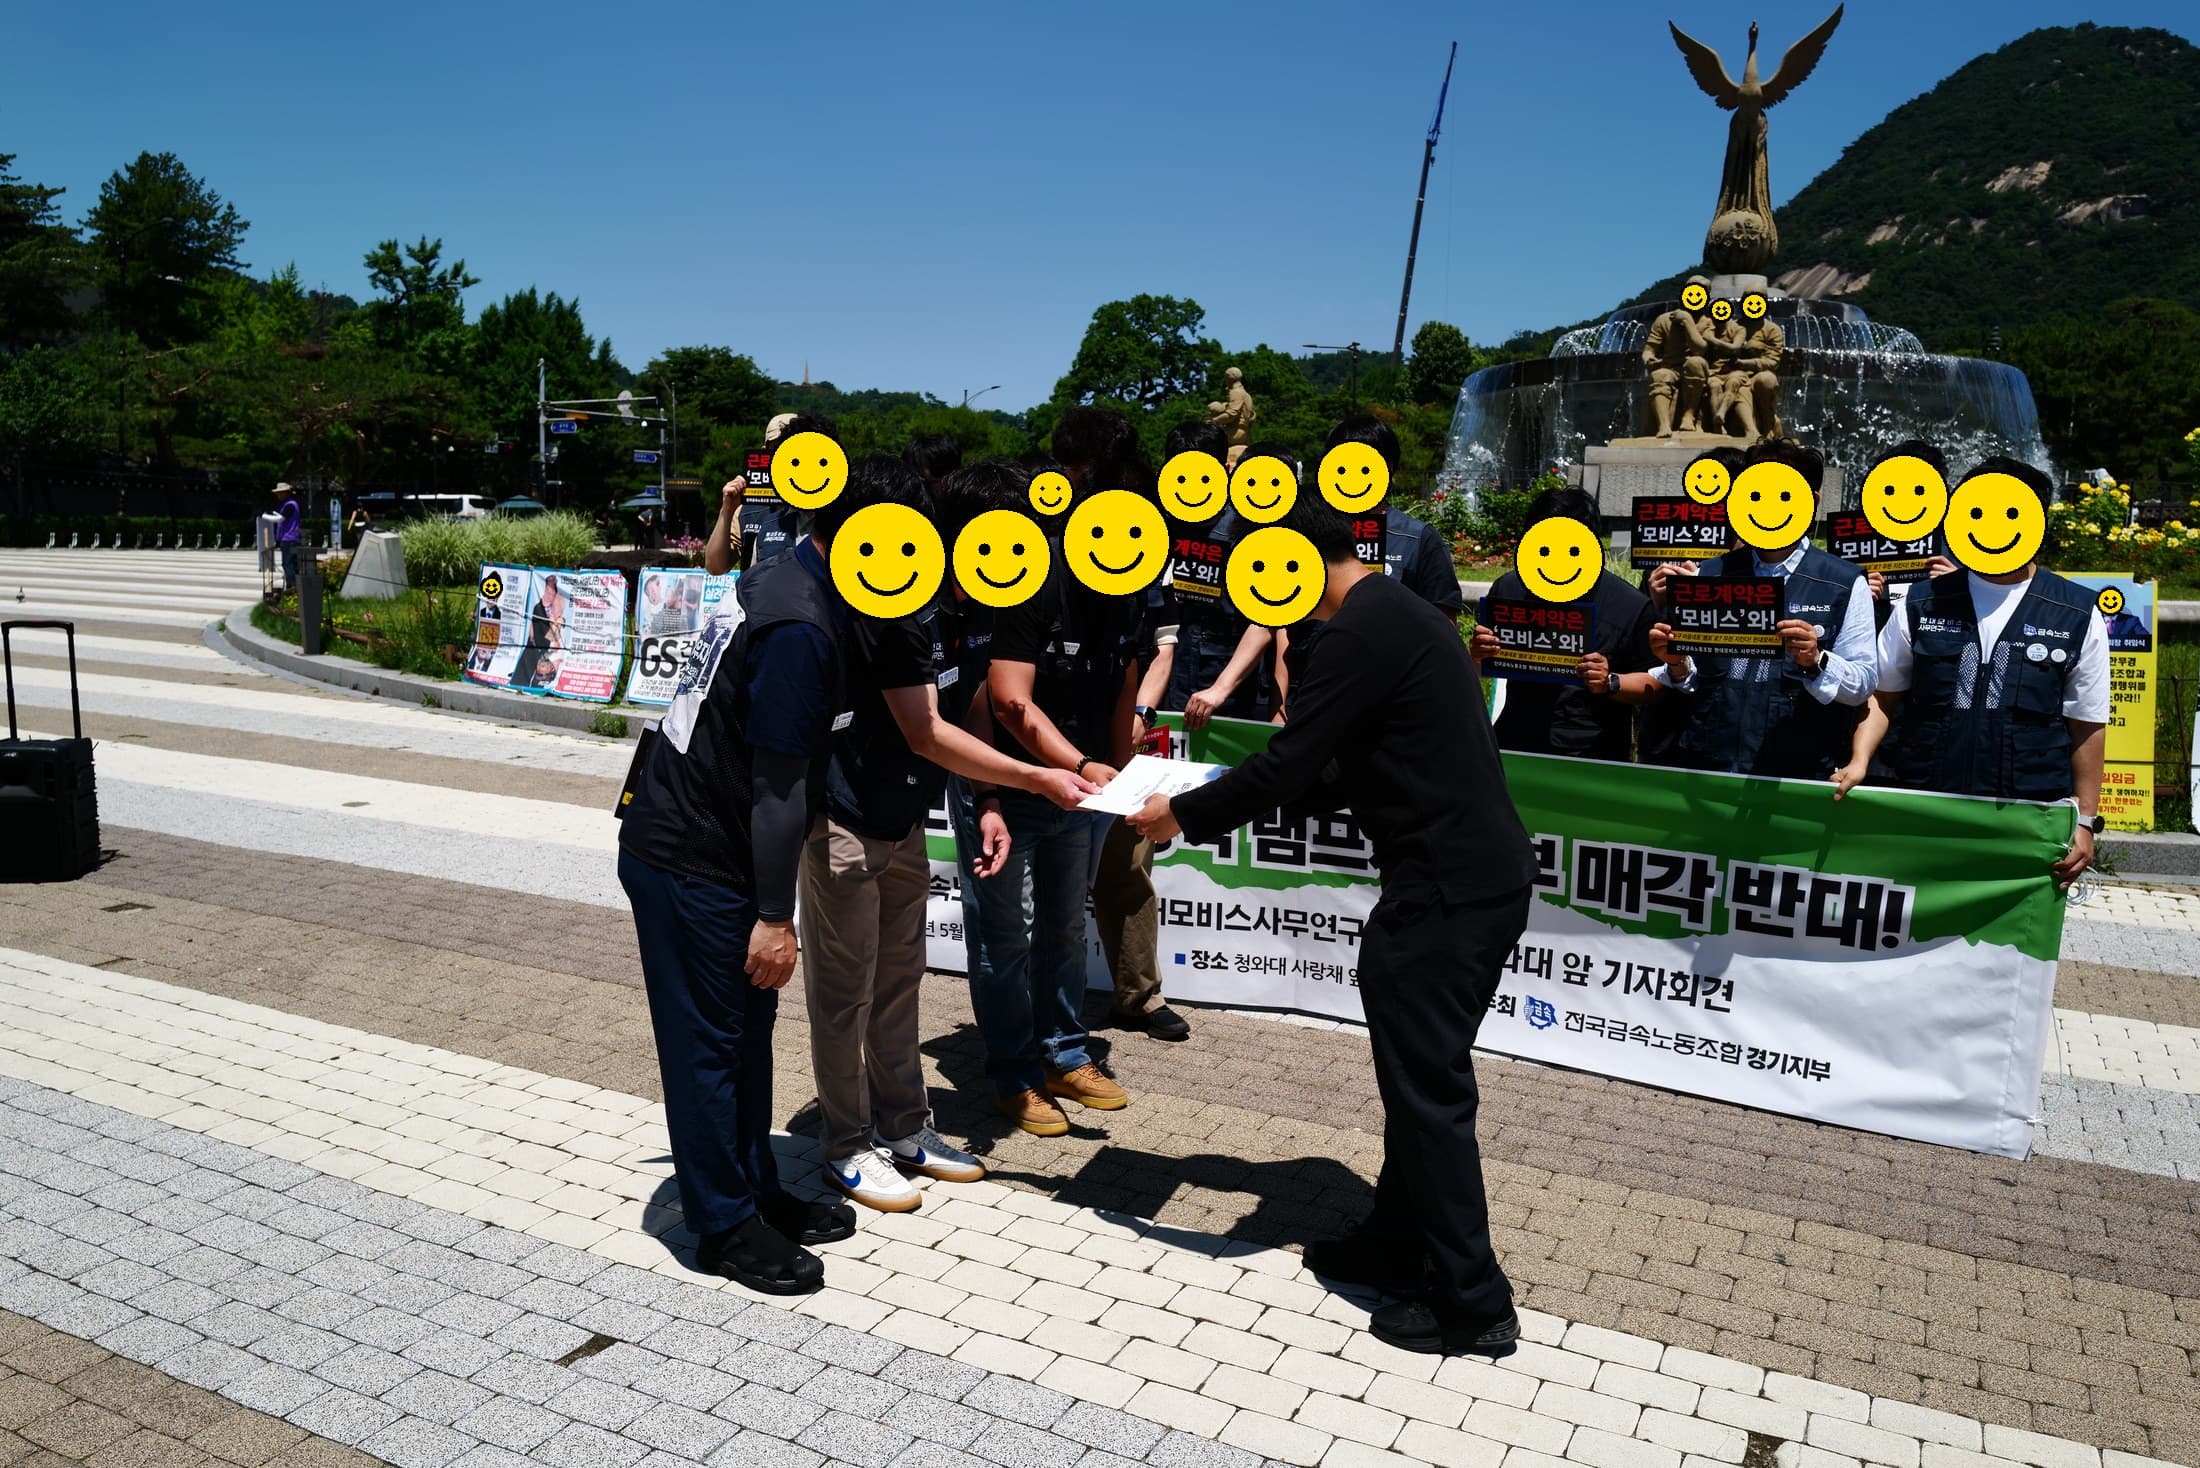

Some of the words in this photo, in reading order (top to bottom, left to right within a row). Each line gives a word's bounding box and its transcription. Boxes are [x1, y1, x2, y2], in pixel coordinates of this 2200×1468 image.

[747, 453, 771, 468] 근로
[1637, 502, 1726, 522] 근로계약은
[1833, 517, 1872, 537] 근로
[1174, 539, 1223, 563] 계약은
[1355, 543, 1379, 561] 와!
[1173, 560, 1220, 584] 스’와!
[1673, 583, 1777, 605] 근로계약은
[1493, 604, 1585, 630] 근로계약은
[2110, 693, 2141, 703] 하라!!
[1576, 843, 1716, 926] 매각
[1731, 865, 1907, 953] 반대!
[1158, 897, 1364, 946] 모비스사무연구
[1191, 949, 1229, 971] 장소
[1233, 953, 1287, 977] 청와대
[1291, 959, 1344, 984] 사랑채
[1562, 952, 1594, 988] 앞
[1602, 959, 1736, 1014] 기자회견
[1563, 1009, 1743, 1066] 전국금속노동조합
[1746, 1045, 1832, 1082] 경기지부
